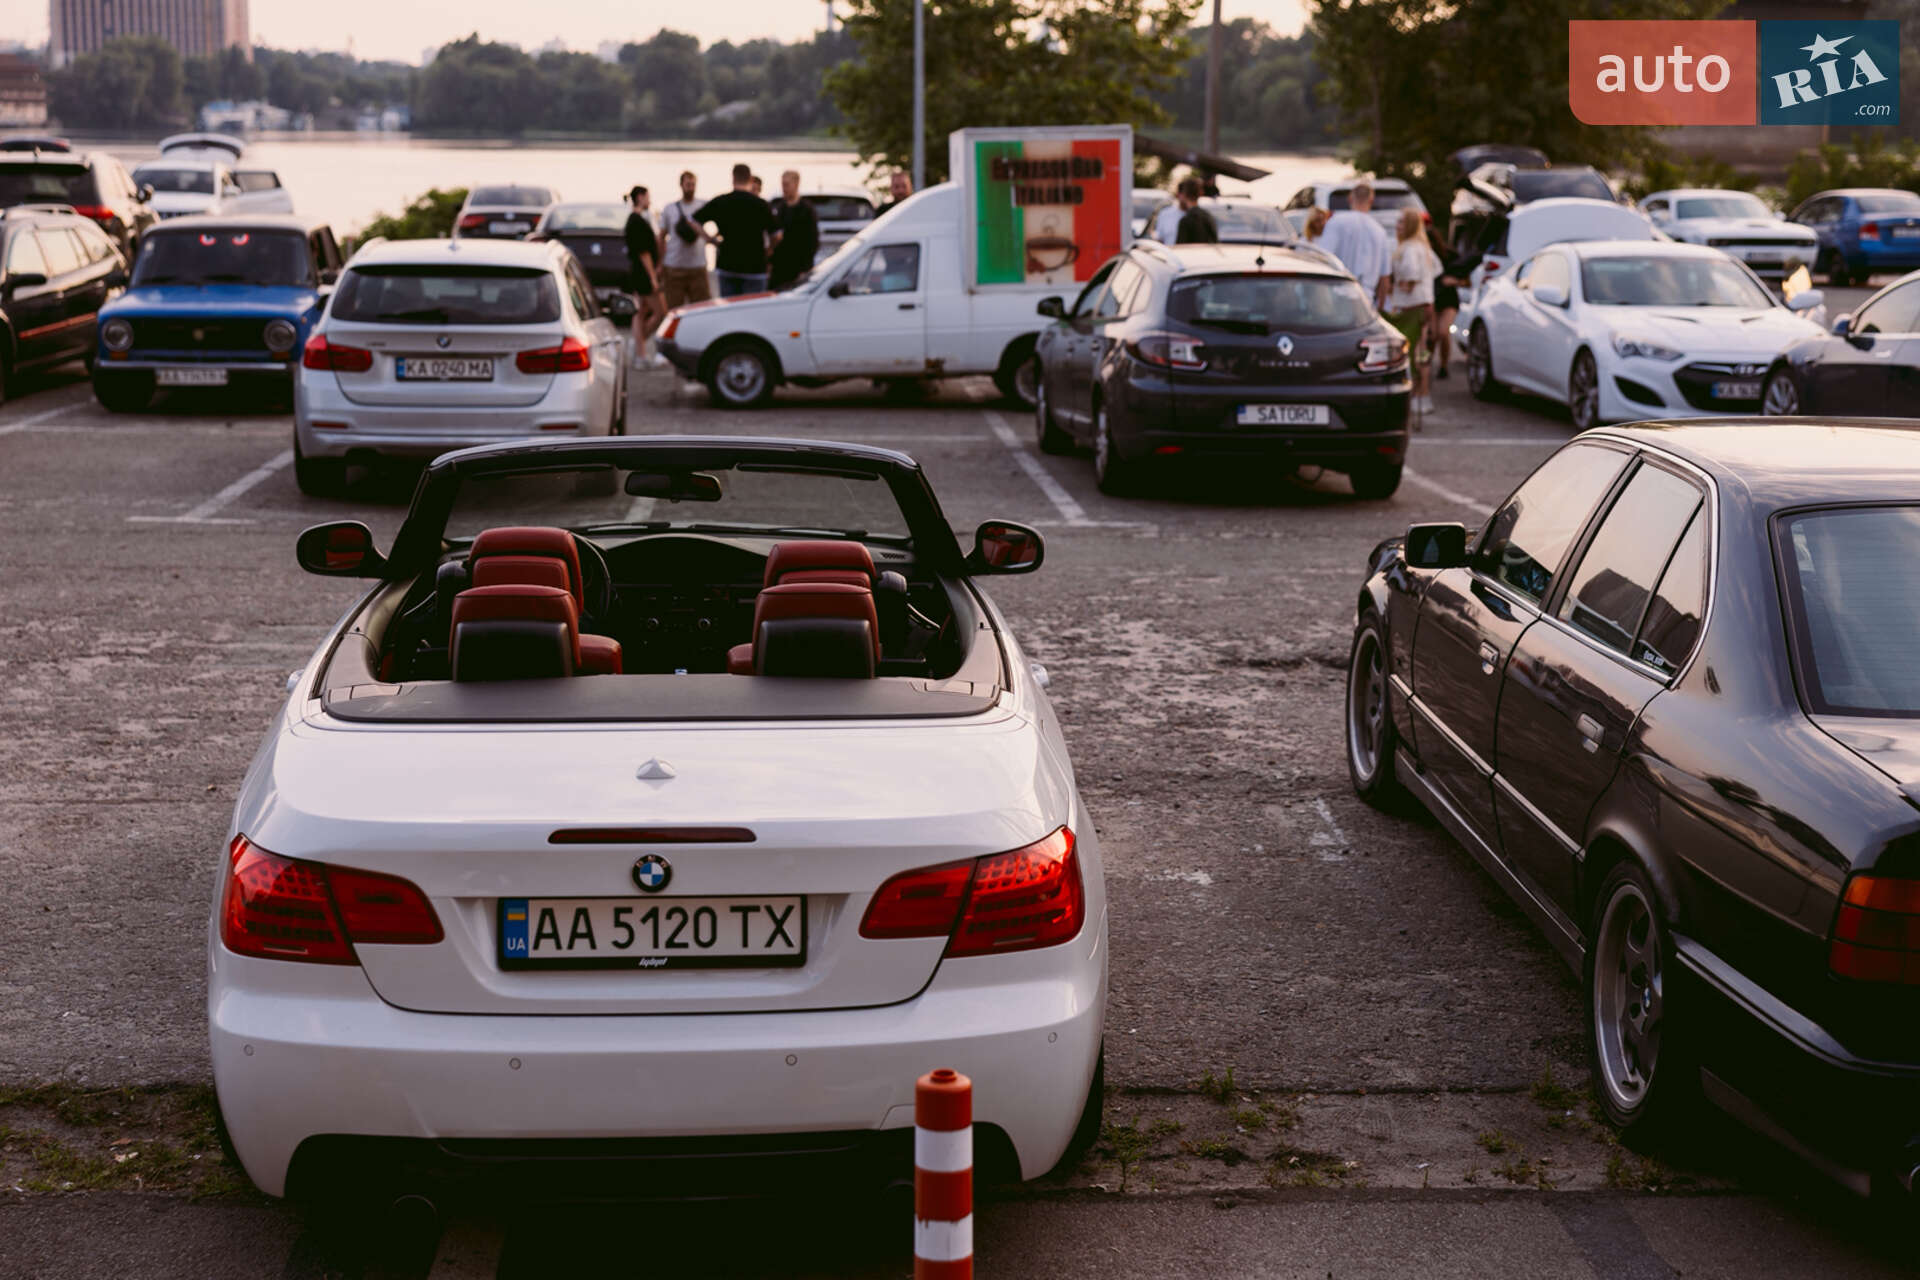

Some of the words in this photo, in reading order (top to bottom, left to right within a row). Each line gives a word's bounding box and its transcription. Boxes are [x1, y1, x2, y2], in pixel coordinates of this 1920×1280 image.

[406, 360, 428, 375] KA
[432, 360, 466, 376] 0240
[468, 360, 491, 375] MA
[1257, 407, 1317, 422] SATORU
[532, 907, 597, 950] AA
[611, 906, 717, 949] 5120
[729, 904, 795, 948] TX
[507, 938, 526, 951] UA
